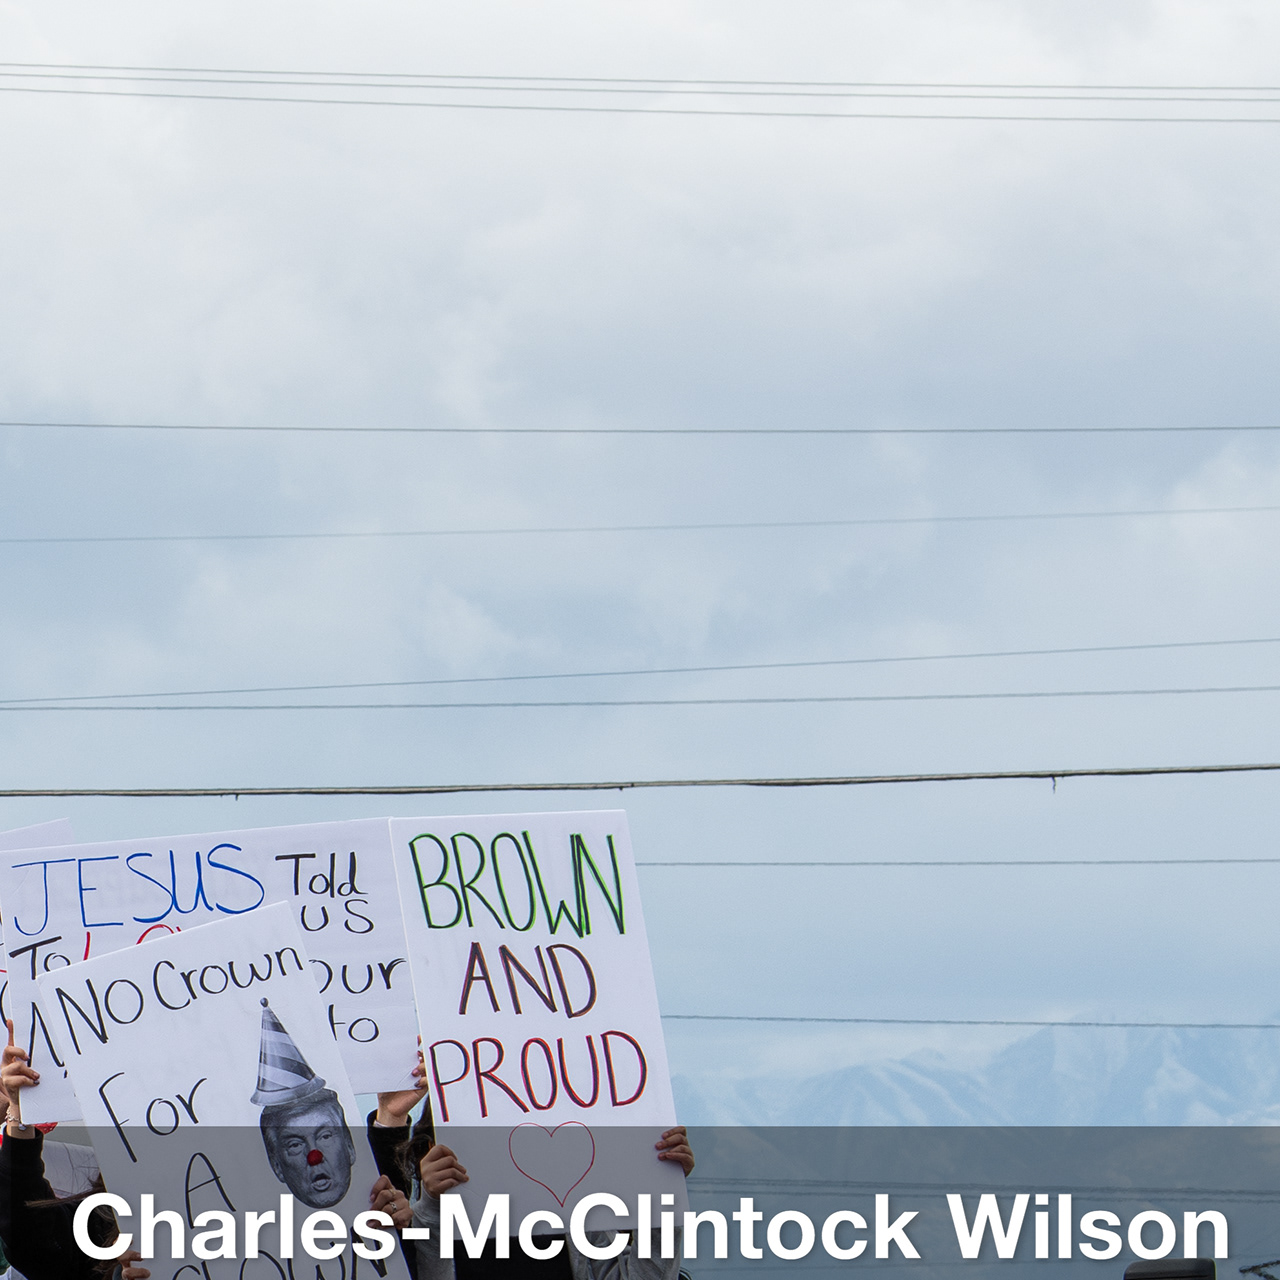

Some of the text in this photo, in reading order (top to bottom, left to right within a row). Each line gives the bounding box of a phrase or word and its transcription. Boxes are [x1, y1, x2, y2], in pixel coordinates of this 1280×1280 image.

[11, 843, 369, 936] JESUS Told
[408, 830, 627, 939] BROWN
[55, 978, 145, 1056] NO
[152, 946, 304, 1011] Crown
[328, 1003, 380, 1043] to
[458, 942, 598, 1019] AND
[97, 1072, 208, 1163] For
[428, 1030, 649, 1123] PROUD
[183, 1152, 237, 1230] A
